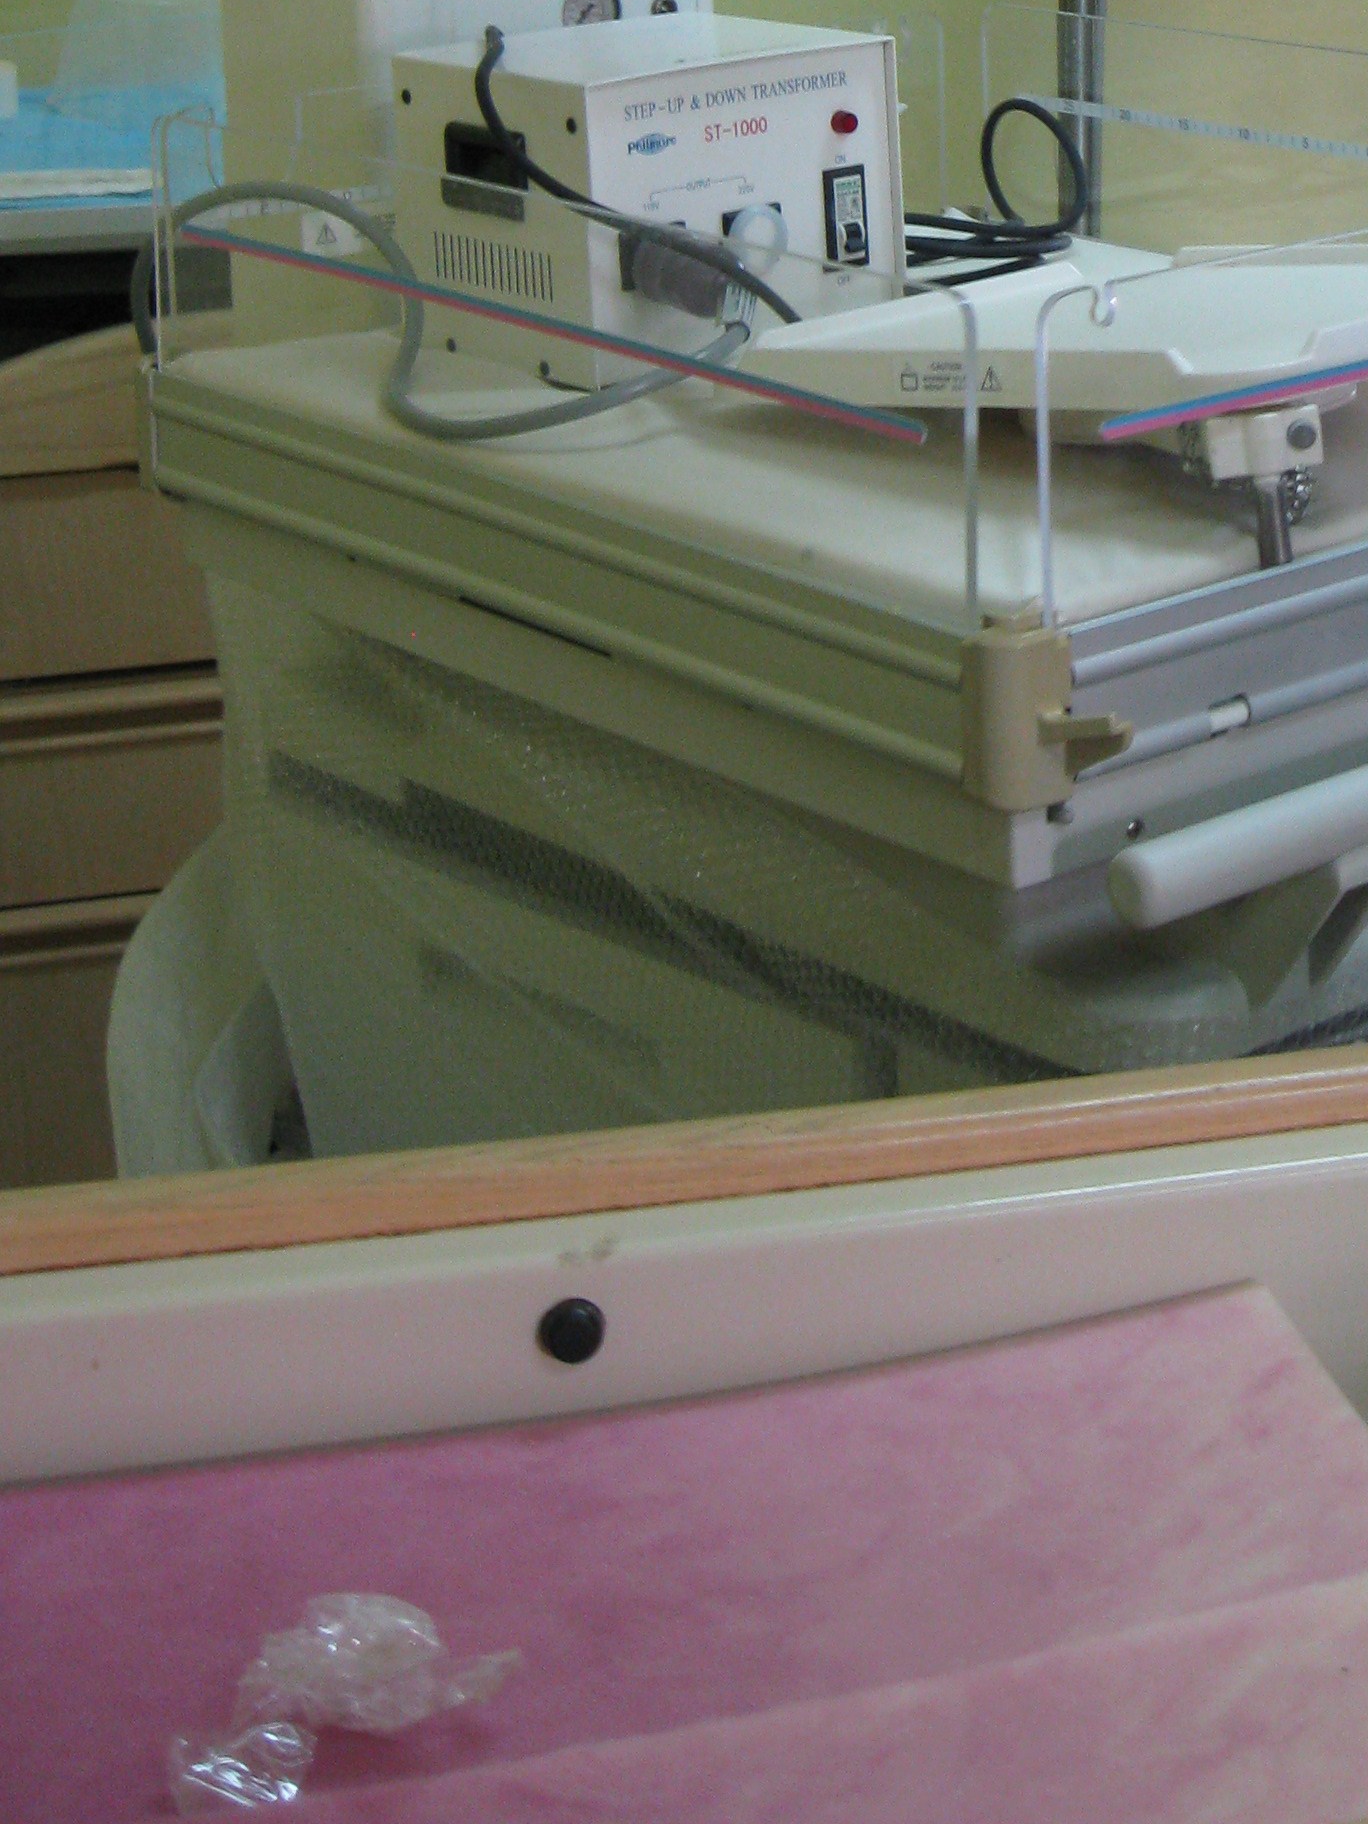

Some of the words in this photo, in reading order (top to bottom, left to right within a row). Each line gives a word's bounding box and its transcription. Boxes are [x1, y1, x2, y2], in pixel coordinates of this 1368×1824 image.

[690, 95, 701, 111] &
[705, 88, 747, 108] DOWN
[750, 70, 848, 100] TRANSFORMER
[703, 116, 768, 143] ST-1000
[1239, 129, 1250, 141] 10
